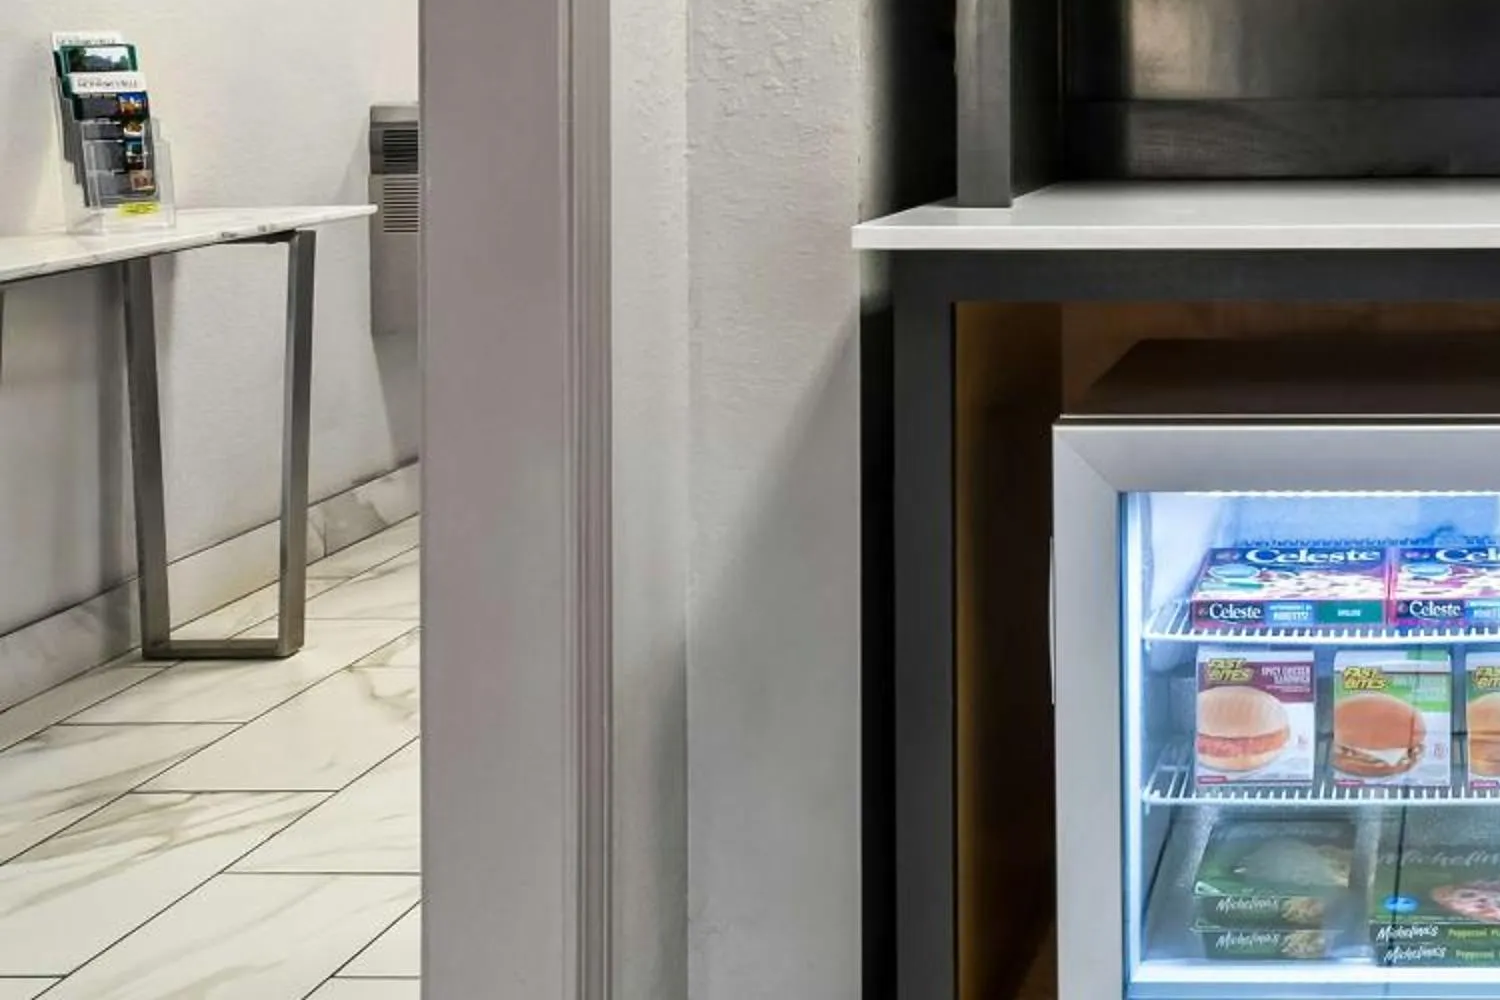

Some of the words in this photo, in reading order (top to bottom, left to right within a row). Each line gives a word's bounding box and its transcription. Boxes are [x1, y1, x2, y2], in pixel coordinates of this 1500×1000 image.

[1246, 548, 1380, 563] Celeste
[1209, 602, 1261, 619] Celeste
[1410, 600, 1461, 617] Celeste
[1208, 658, 1246, 670] FAST
[1208, 668, 1252, 681] BITES
[1343, 666, 1380, 678] FAST
[1344, 677, 1388, 689] BITES
